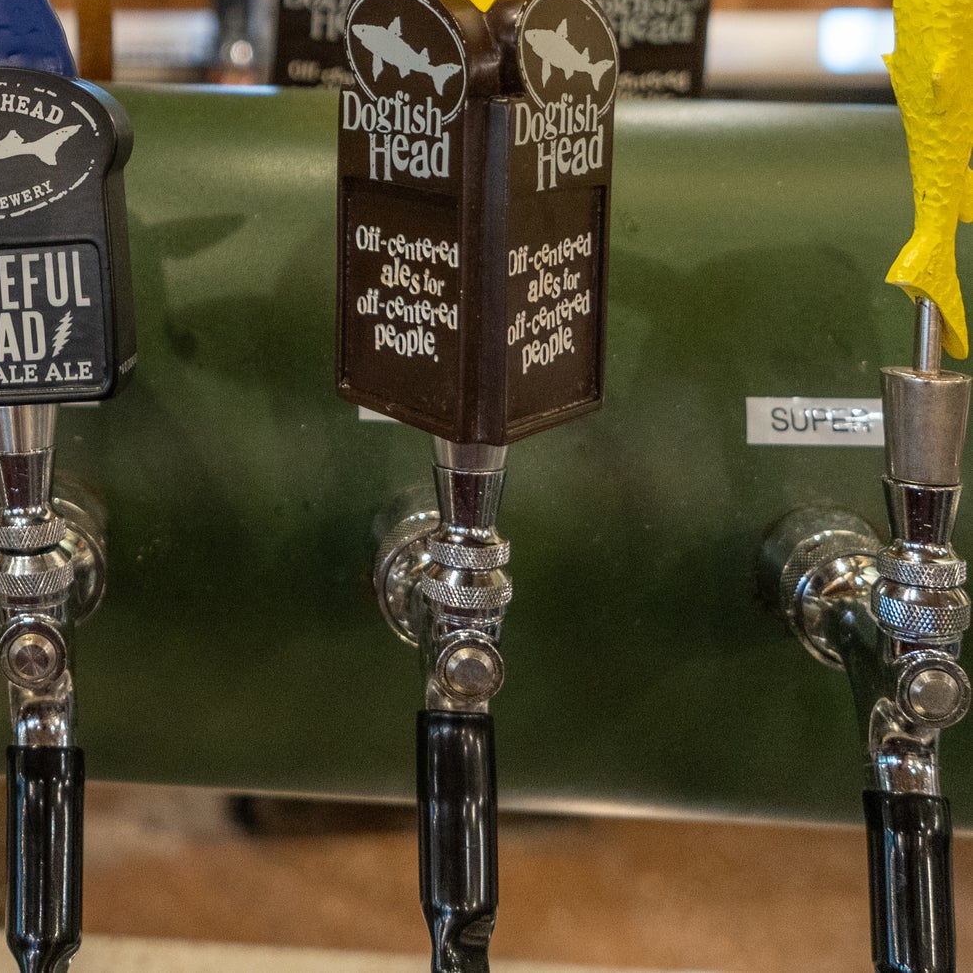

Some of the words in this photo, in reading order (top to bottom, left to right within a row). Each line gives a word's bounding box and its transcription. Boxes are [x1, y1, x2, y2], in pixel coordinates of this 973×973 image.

[0, 93, 65, 125] HEAD
[342, 90, 442, 138] Dogfish
[514, 92, 598, 146] Dogfish
[368, 131, 450, 182] Head
[535, 123, 604, 192] Head
[355, 224, 460, 268] Off-centered
[508, 231, 592, 277] Off-centered
[380, 257, 421, 295] ales
[423, 268, 445, 297] for
[527, 268, 561, 303] ales
[563, 267, 581, 291] for
[356, 287, 458, 330] off-centered
[507, 289, 590, 346] off-centered
[374, 323, 439, 363] people.
[521, 325, 575, 375] people.
[44, 360, 94, 382] ALE
